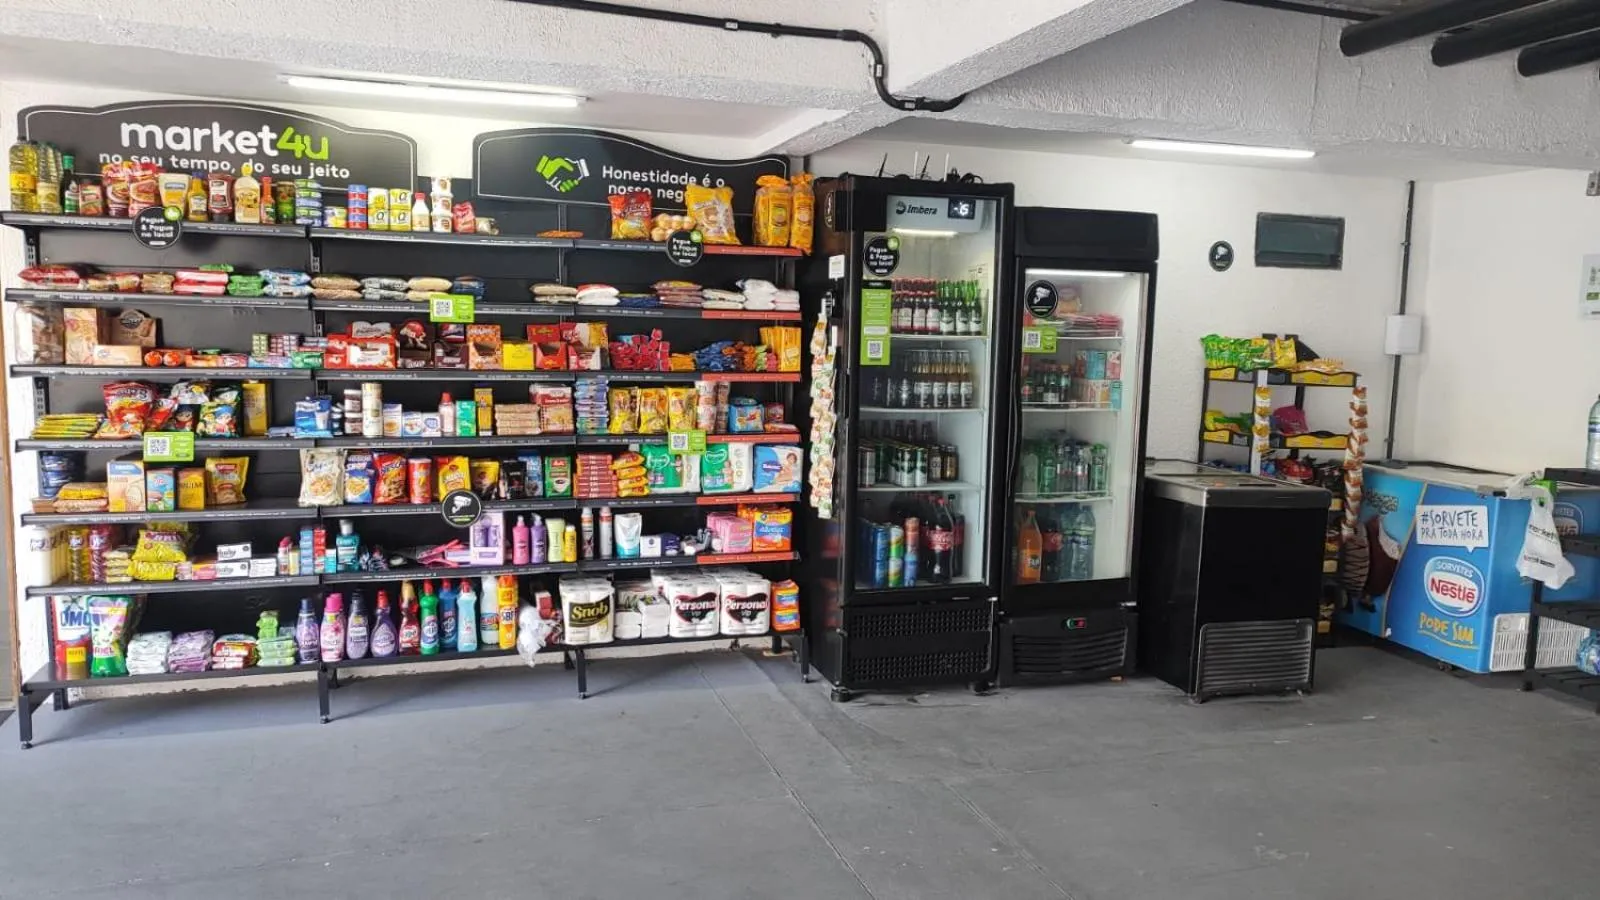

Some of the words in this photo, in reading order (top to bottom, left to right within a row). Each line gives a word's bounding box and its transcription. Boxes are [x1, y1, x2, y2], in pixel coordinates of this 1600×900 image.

[120, 121, 330, 160] market4u
[99, 153, 123, 165] no
[170, 155, 236, 174] tempo,
[271, 163, 302, 175] seu
[308, 162, 350, 179] jeito
[602, 165, 697, 185] Honestidade
[702, 173, 711, 187] é
[716, 178, 725, 187] o
[656, 187, 685, 203] neg
[1421, 510, 1478, 527] #SORVETE
[1421, 528, 1436, 539] PRA
[1438, 527, 1458, 538] TODA
[1461, 528, 1484, 541] HORA
[1436, 562, 1474, 578] SORVETES
[571, 601, 609, 620] Snob
[726, 599, 768, 611] Personal
[1419, 612, 1449, 635] PODE
[1452, 621, 1475, 645] SIM
